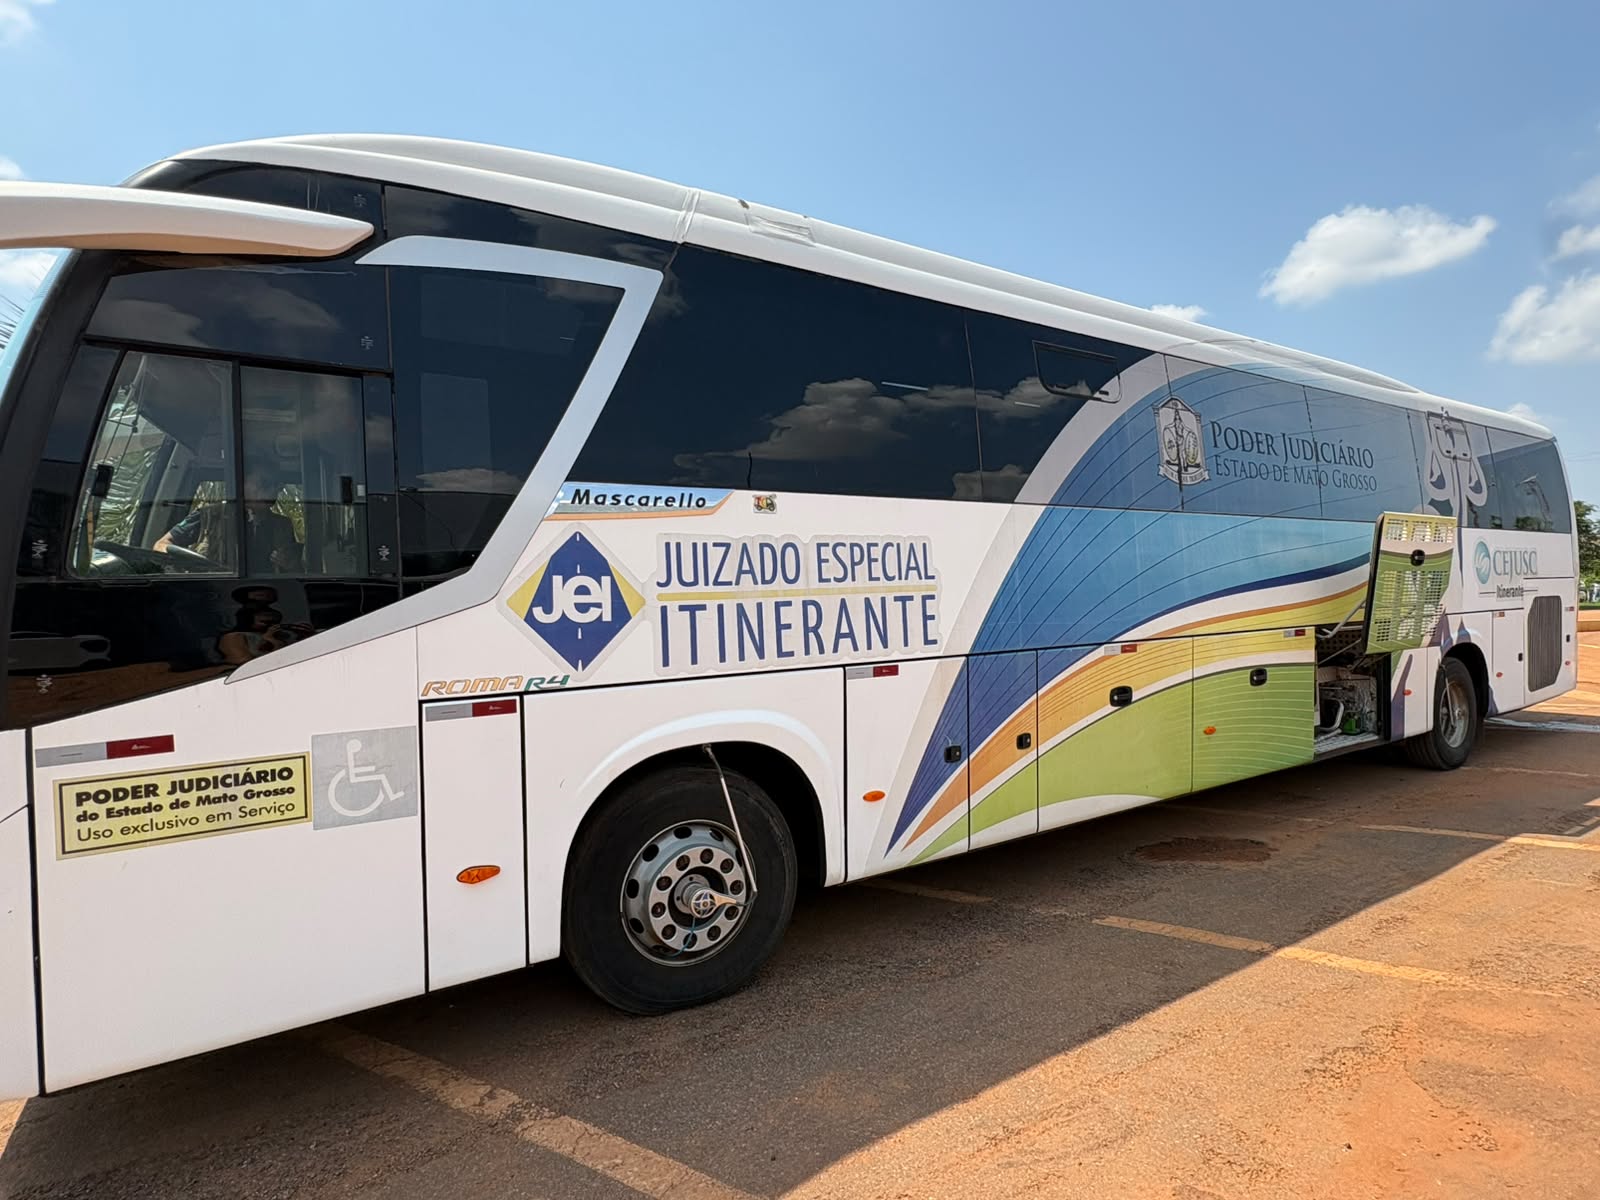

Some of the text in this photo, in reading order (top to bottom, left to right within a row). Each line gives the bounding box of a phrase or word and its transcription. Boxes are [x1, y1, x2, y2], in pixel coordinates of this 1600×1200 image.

[1210, 420, 1374, 469] PODER JUDICIÁRIO
[1214, 454, 1269, 480] ESTADO
[1273, 464, 1289, 483] DE
[1290, 464, 1328, 487] MATO
[1333, 469, 1377, 491] GROSSO
[571, 489, 706, 508] Mascarello
[656, 541, 936, 588] JUIZADO ESPECIAL
[1493, 550, 1537, 584] CEJUSC
[659, 594, 938, 667] ITINERANTE
[421, 675, 524, 697] ROMA
[75, 767, 293, 807] PODER JUDICIÁRIO
[76, 786, 295, 823] do Estado de Mato Grosso
[77, 801, 295, 842] Uso exclusivo em Serviço
